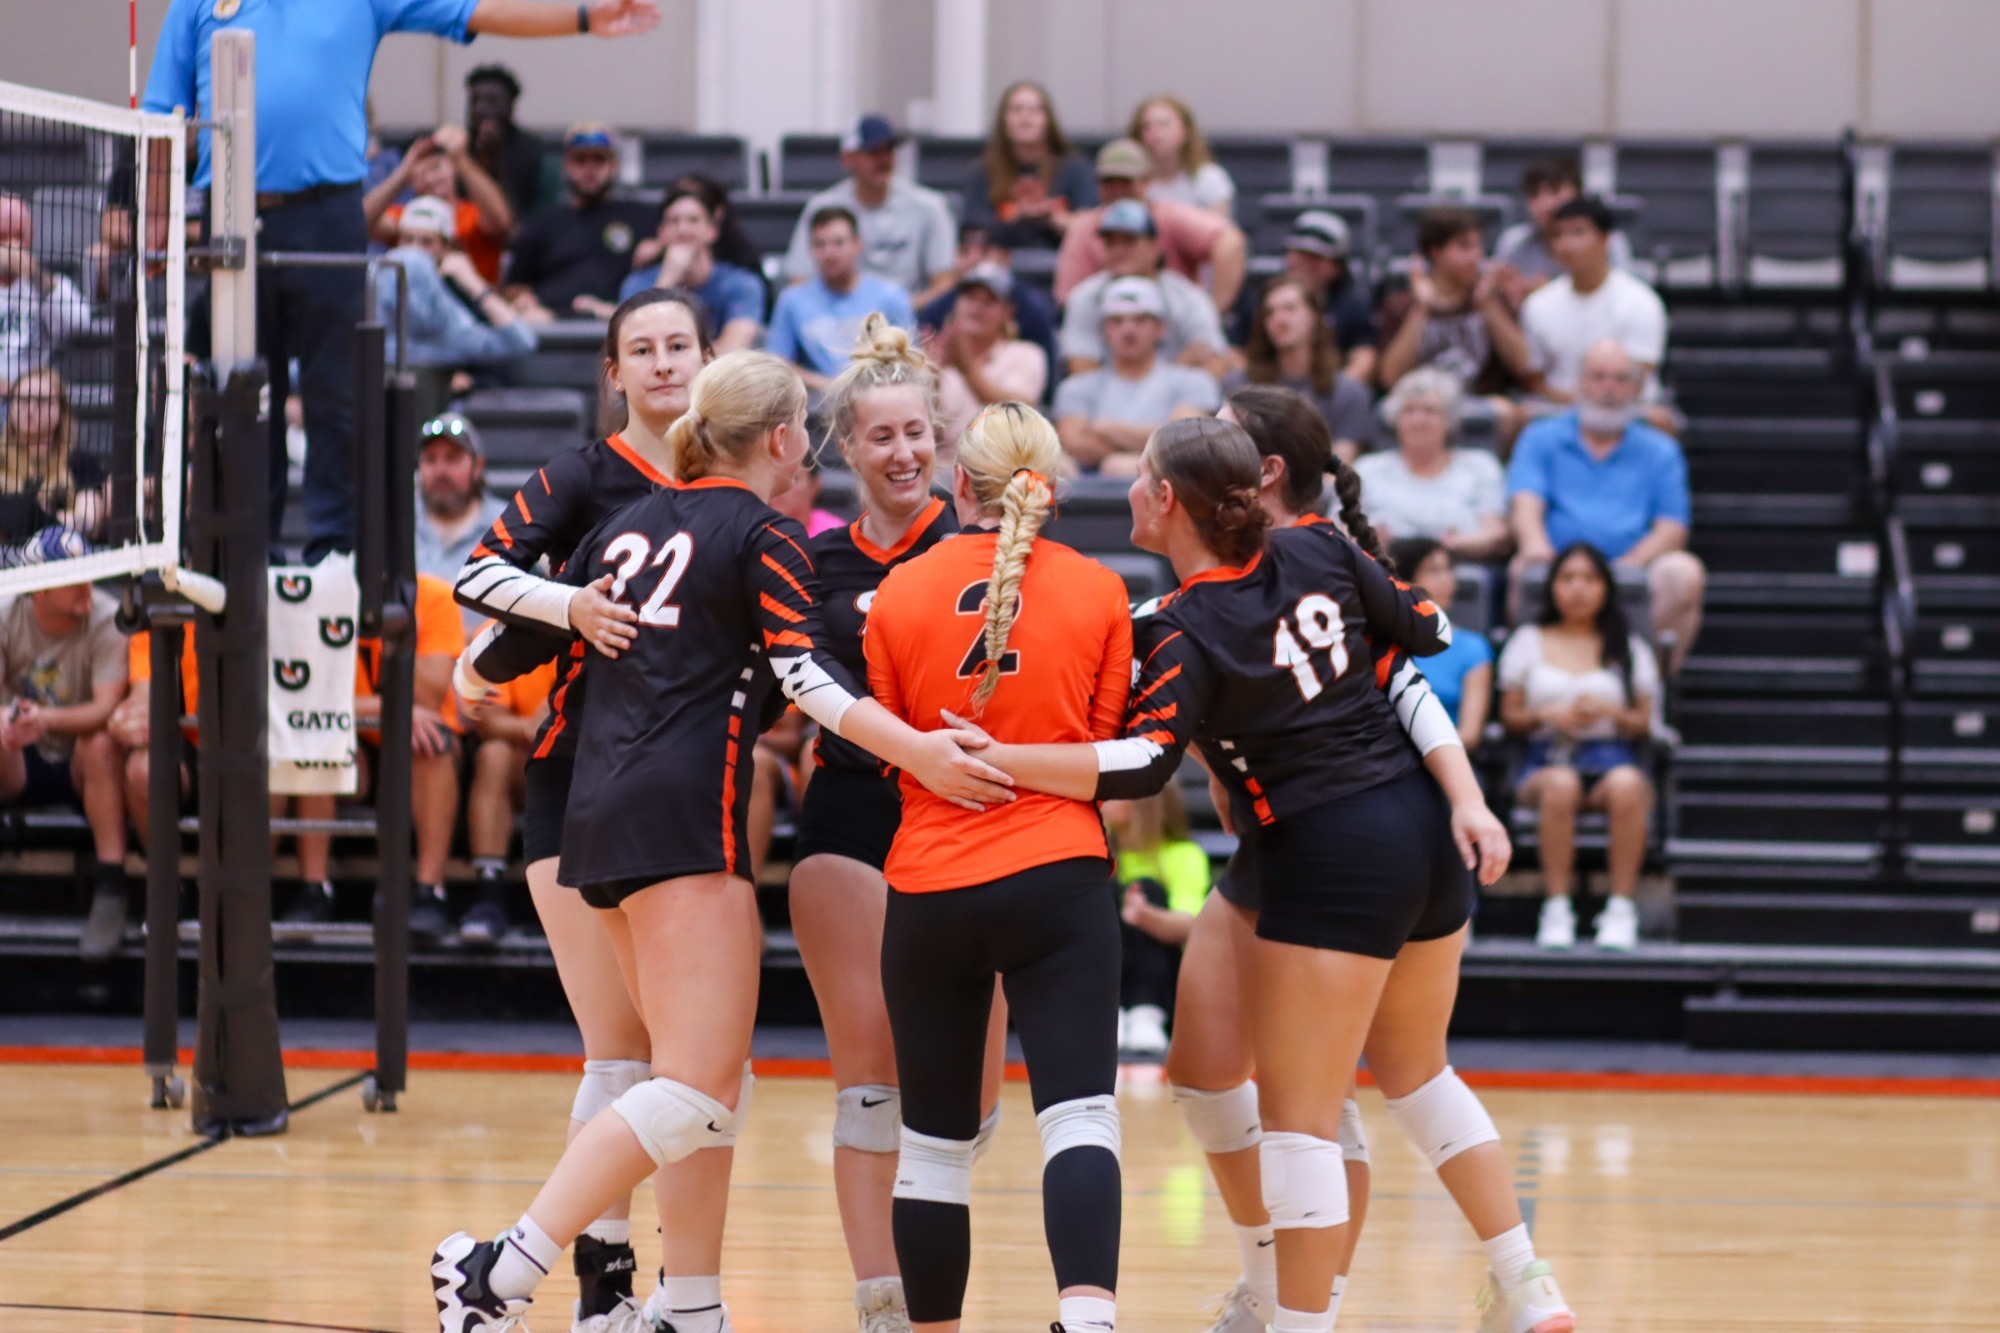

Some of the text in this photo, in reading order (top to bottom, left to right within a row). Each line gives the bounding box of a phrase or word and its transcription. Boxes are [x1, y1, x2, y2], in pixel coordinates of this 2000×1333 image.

[275, 574, 312, 604] G
[600, 530, 694, 629] 22
[318, 616, 354, 649] G
[954, 578, 1022, 680] 2
[1271, 591, 1350, 704] 19
[273, 657, 311, 692] G
